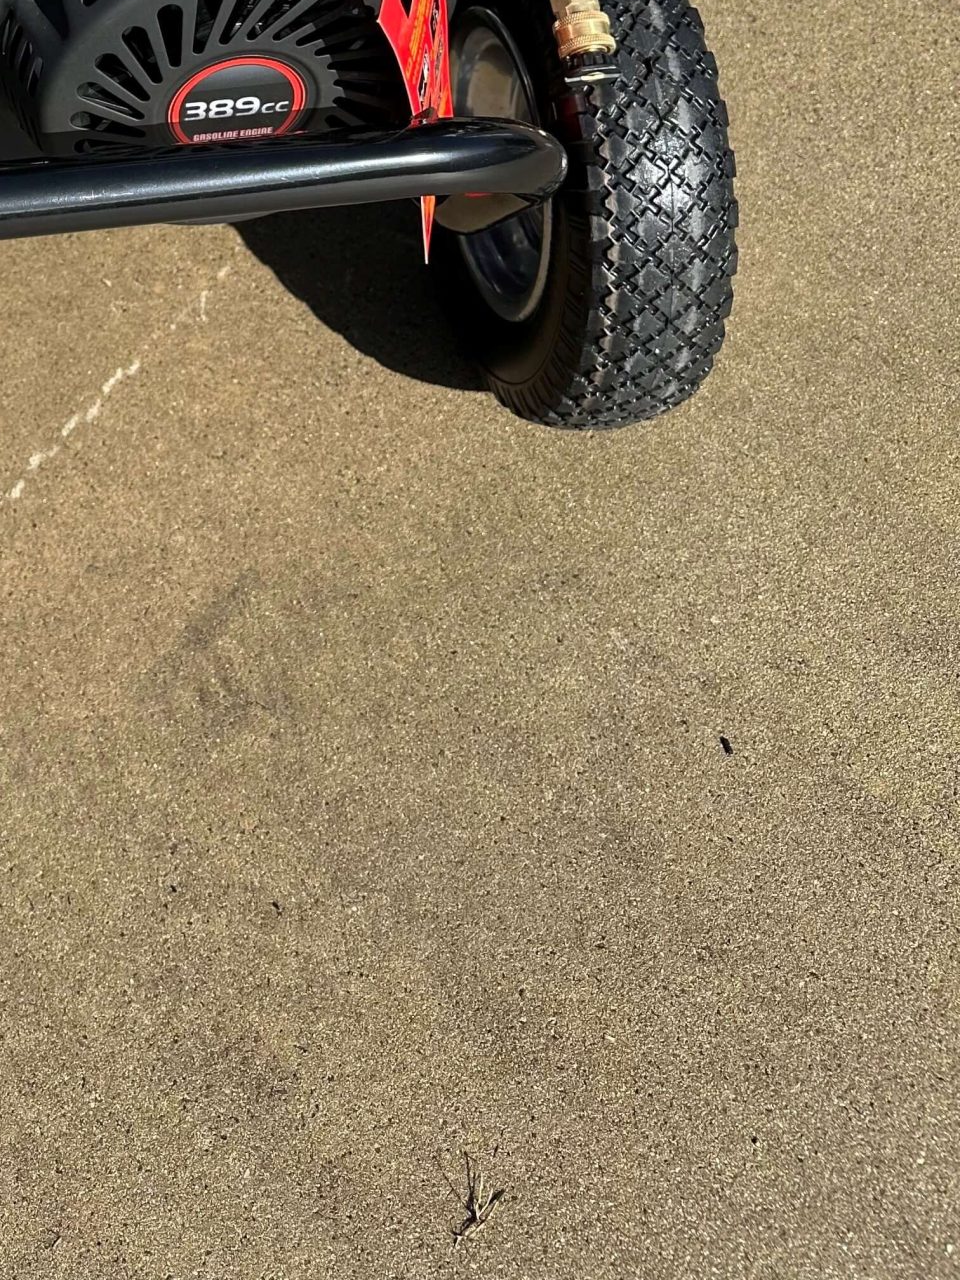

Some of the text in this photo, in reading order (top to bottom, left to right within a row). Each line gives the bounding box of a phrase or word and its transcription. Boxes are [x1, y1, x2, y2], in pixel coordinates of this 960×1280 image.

[183, 96, 290, 122] 389cc
[192, 126, 273, 143] GASOLINE ENGINE
